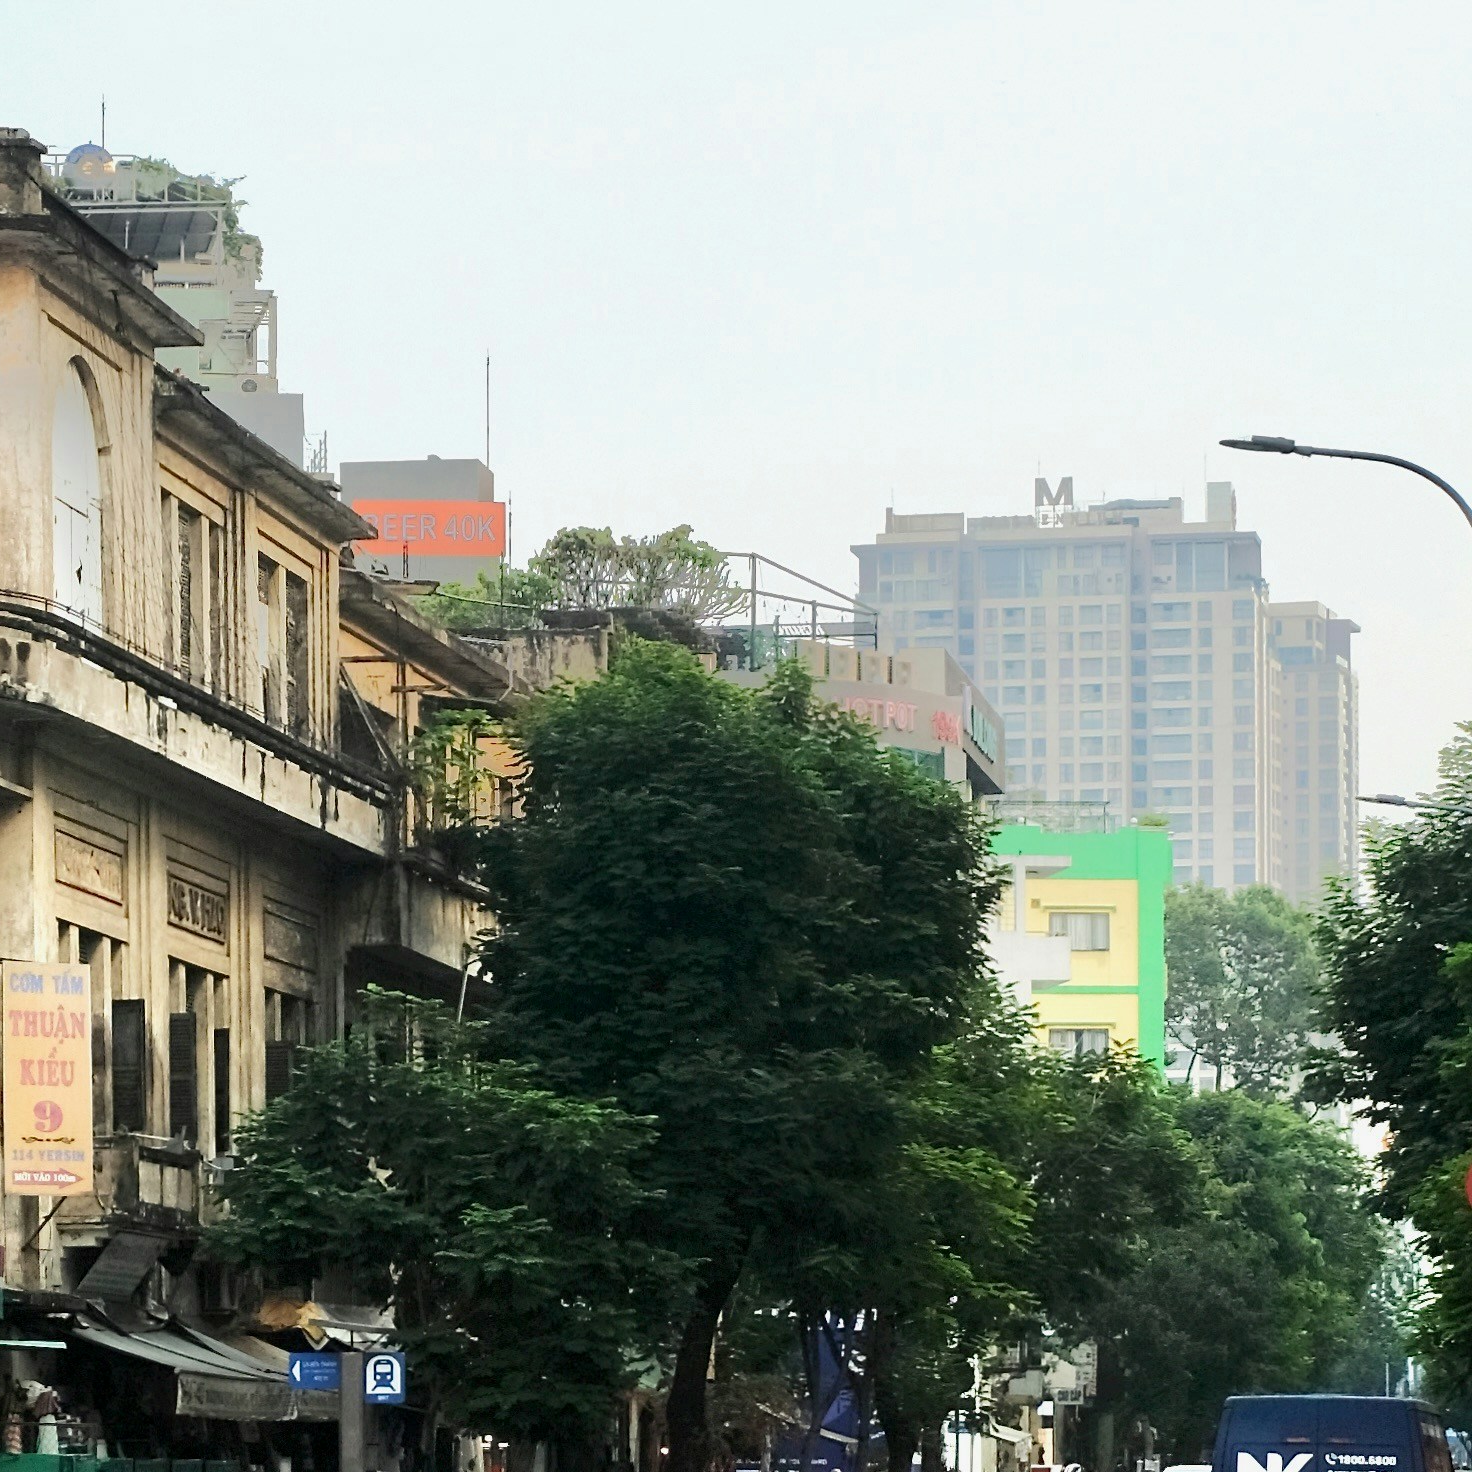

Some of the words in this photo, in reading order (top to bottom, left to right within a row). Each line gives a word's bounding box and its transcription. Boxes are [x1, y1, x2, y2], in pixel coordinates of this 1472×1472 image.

[444, 514, 496, 541] 40K
[883, 701, 918, 732] POT
[52, 968, 84, 995] TẤM
[9, 1004, 85, 1044] THUẬN
[33, 1100, 63, 1132] 9
[39, 1149, 85, 1161] YERSIN
